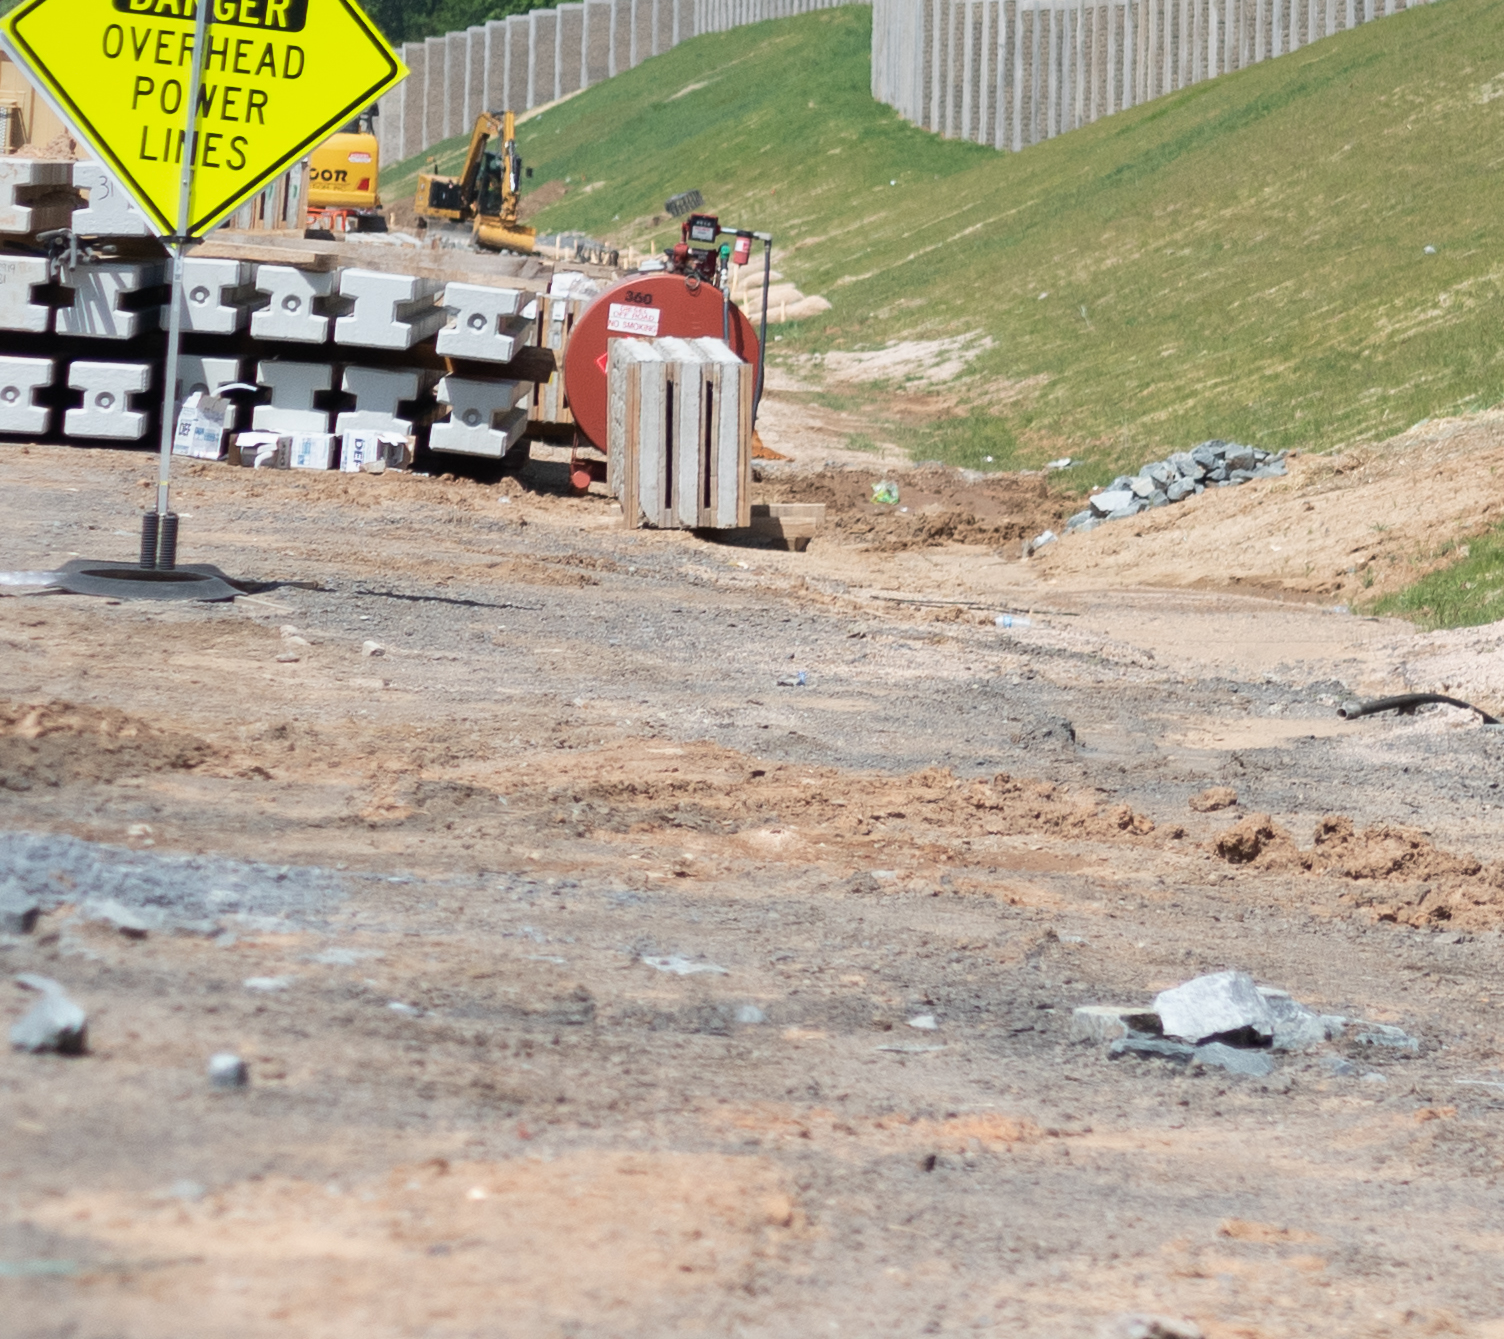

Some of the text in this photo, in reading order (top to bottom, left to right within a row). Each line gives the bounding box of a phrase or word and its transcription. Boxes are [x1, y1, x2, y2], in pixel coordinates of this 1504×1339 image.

[102, 23, 305, 80] OVERHEAD
[131, 75, 268, 125] POWER
[139, 125, 249, 171] LINES
[625, 290, 653, 305] 360
[608, 319, 656, 333] NO SMOKING
